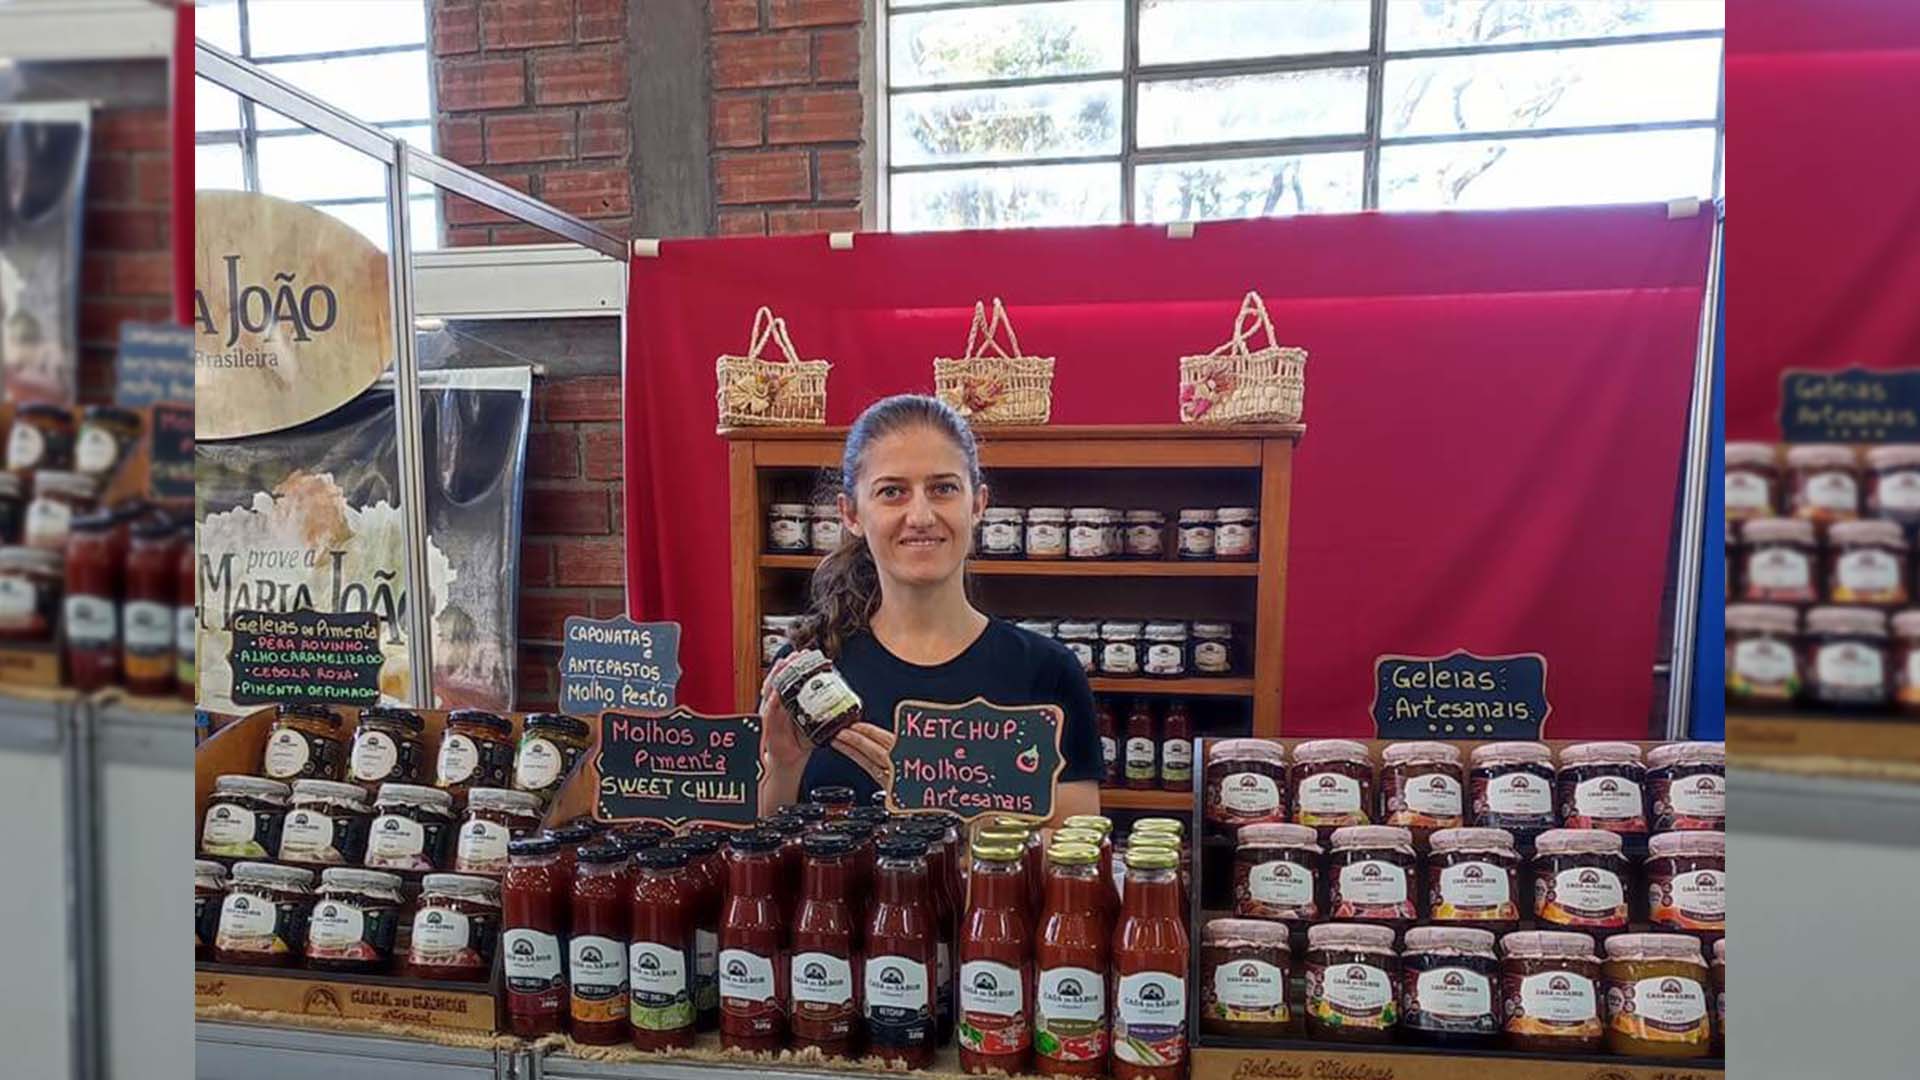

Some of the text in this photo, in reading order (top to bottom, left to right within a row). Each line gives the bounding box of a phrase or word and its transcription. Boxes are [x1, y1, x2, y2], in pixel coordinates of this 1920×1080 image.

[247, 548, 317, 574] prove a
[235, 615, 299, 635] Geleias
[317, 618, 378, 639] Pimenta
[569, 625, 653, 648] CAPONATAS
[643, 648, 653, 659] e
[252, 666, 353, 680] CEBOLA ROXA
[568, 657, 661, 681] ANTEPASTOS
[1392, 661, 1496, 691] Geleias
[241, 681, 303, 696] PIMENTA
[567, 681, 668, 708] Molho Pesto
[1395, 694, 1530, 720] Artesanais
[612, 719, 737, 748] Molhos DE
[906, 711, 1018, 741] KETCHUP
[635, 749, 727, 771] Pimenta
[954, 747, 967, 760] e
[903, 758, 989, 784] Molhos
[601, 776, 746, 801] SWEET CHILLI
[922, 786, 1033, 811] Artesanais
